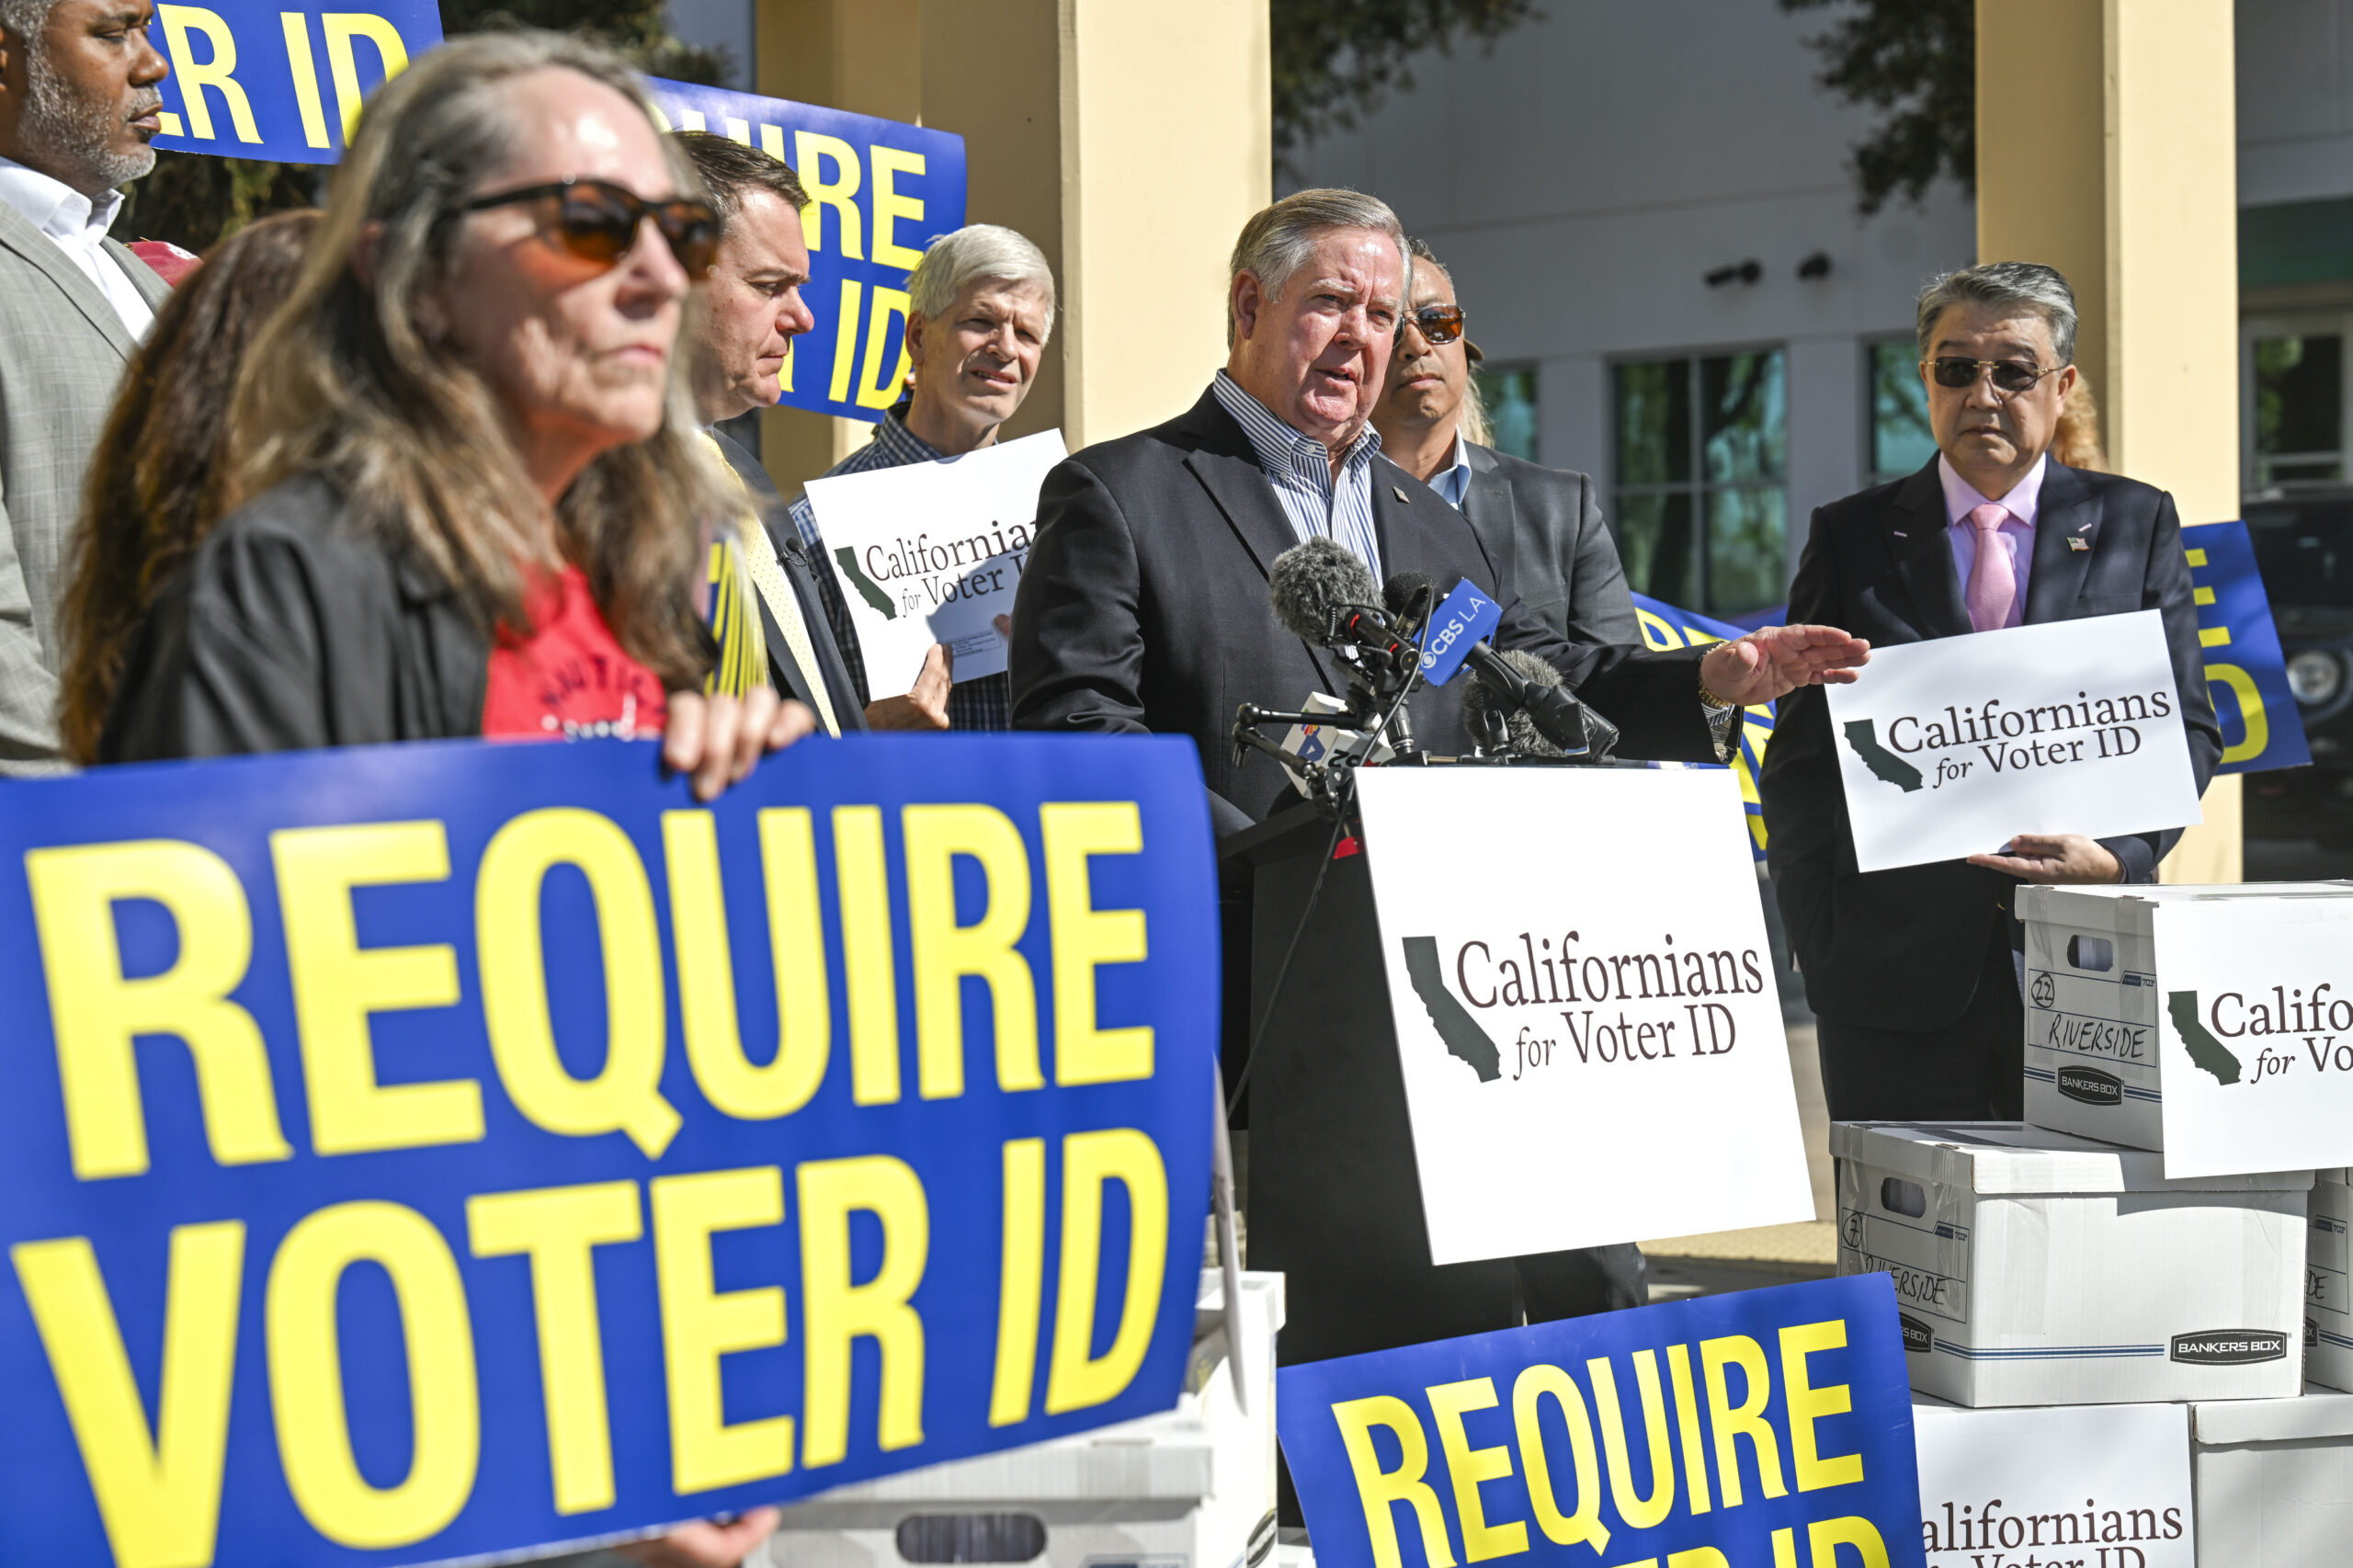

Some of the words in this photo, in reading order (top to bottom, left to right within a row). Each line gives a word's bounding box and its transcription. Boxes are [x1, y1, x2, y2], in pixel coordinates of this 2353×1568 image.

[279, 11, 410, 149] ID
[866, 519, 1037, 582] California
[902, 587, 921, 619] for
[921, 567, 1005, 606] Voter
[1430, 618, 1464, 655] CBS
[1458, 597, 1486, 622] LA
[1888, 690, 2171, 754] Californians
[1932, 756, 1973, 790] for
[1978, 739, 2084, 773] Voter
[2092, 725, 2142, 759] ID
[24, 800, 1155, 1181] REQUIRE
[1456, 930, 1764, 1008] Californians
[1513, 1026, 1557, 1081] for
[1561, 1010, 1677, 1064] Voter
[1683, 1003, 1736, 1056] ID
[2048, 1013, 2147, 1058] RIVERSIDE
[2250, 1047, 2296, 1085] for
[2061, 1075, 2099, 1091] BANKERS
[2100, 1085, 2119, 1096] BOX
[9, 1153, 925, 1568] VOTER
[988, 1126, 1169, 1428] ID
[1910, 1329, 1928, 1345] BOX
[2177, 1342, 2248, 1354] BANKERS
[2250, 1340, 2281, 1352] BOX
[1330, 1318, 1865, 1568] REQUIRE
